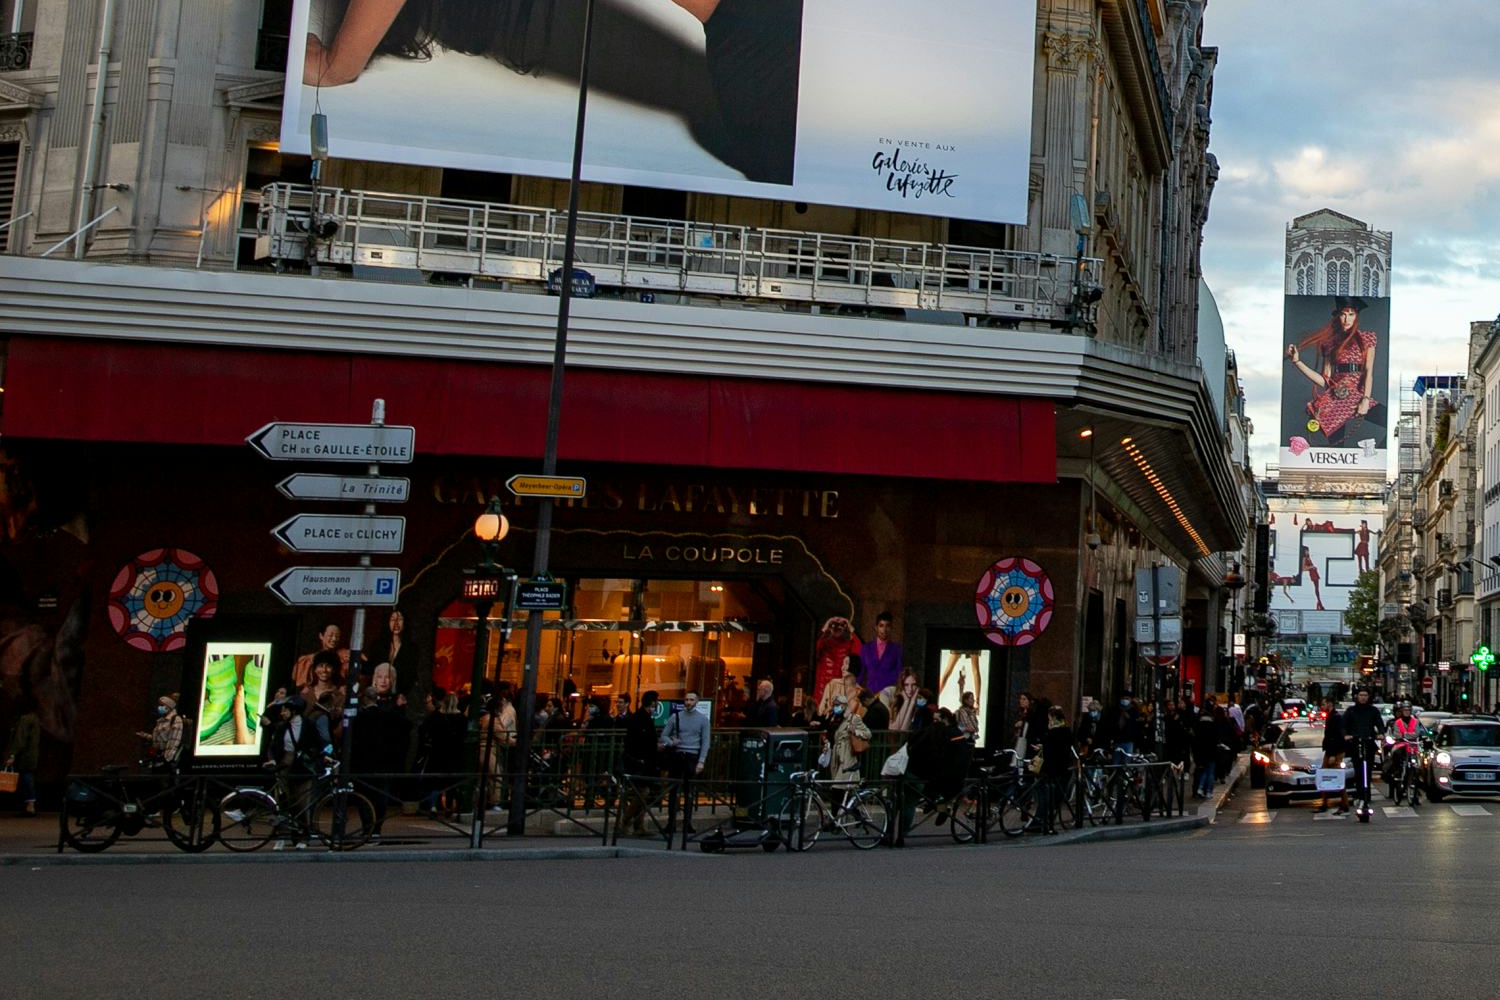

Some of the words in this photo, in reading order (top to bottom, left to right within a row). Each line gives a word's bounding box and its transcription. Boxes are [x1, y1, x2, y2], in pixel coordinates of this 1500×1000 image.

[879, 137, 893, 145] EN
[897, 140, 931, 149] VENTE
[936, 144, 956, 152] AUX
[872, 148, 930, 175] Galeries
[886, 169, 959, 199] Lafayette
[282, 430, 321, 440] PLACE
[281, 444, 297, 453] CH
[313, 444, 407, 456] GAULLE-ÉTOILE
[1309, 451, 1358, 465] VERSACE
[342, 483, 355, 493] La
[363, 483, 403, 495] Trinité
[304, 528, 341, 538] PLACE
[356, 530, 398, 540] CLICHY
[622, 545, 655, 560] LA
[665, 545, 784, 564] COUPOLE
[303, 575, 351, 584] Haussmann
[302, 587, 331, 596] Grands
[334, 587, 373, 597] Magasins
